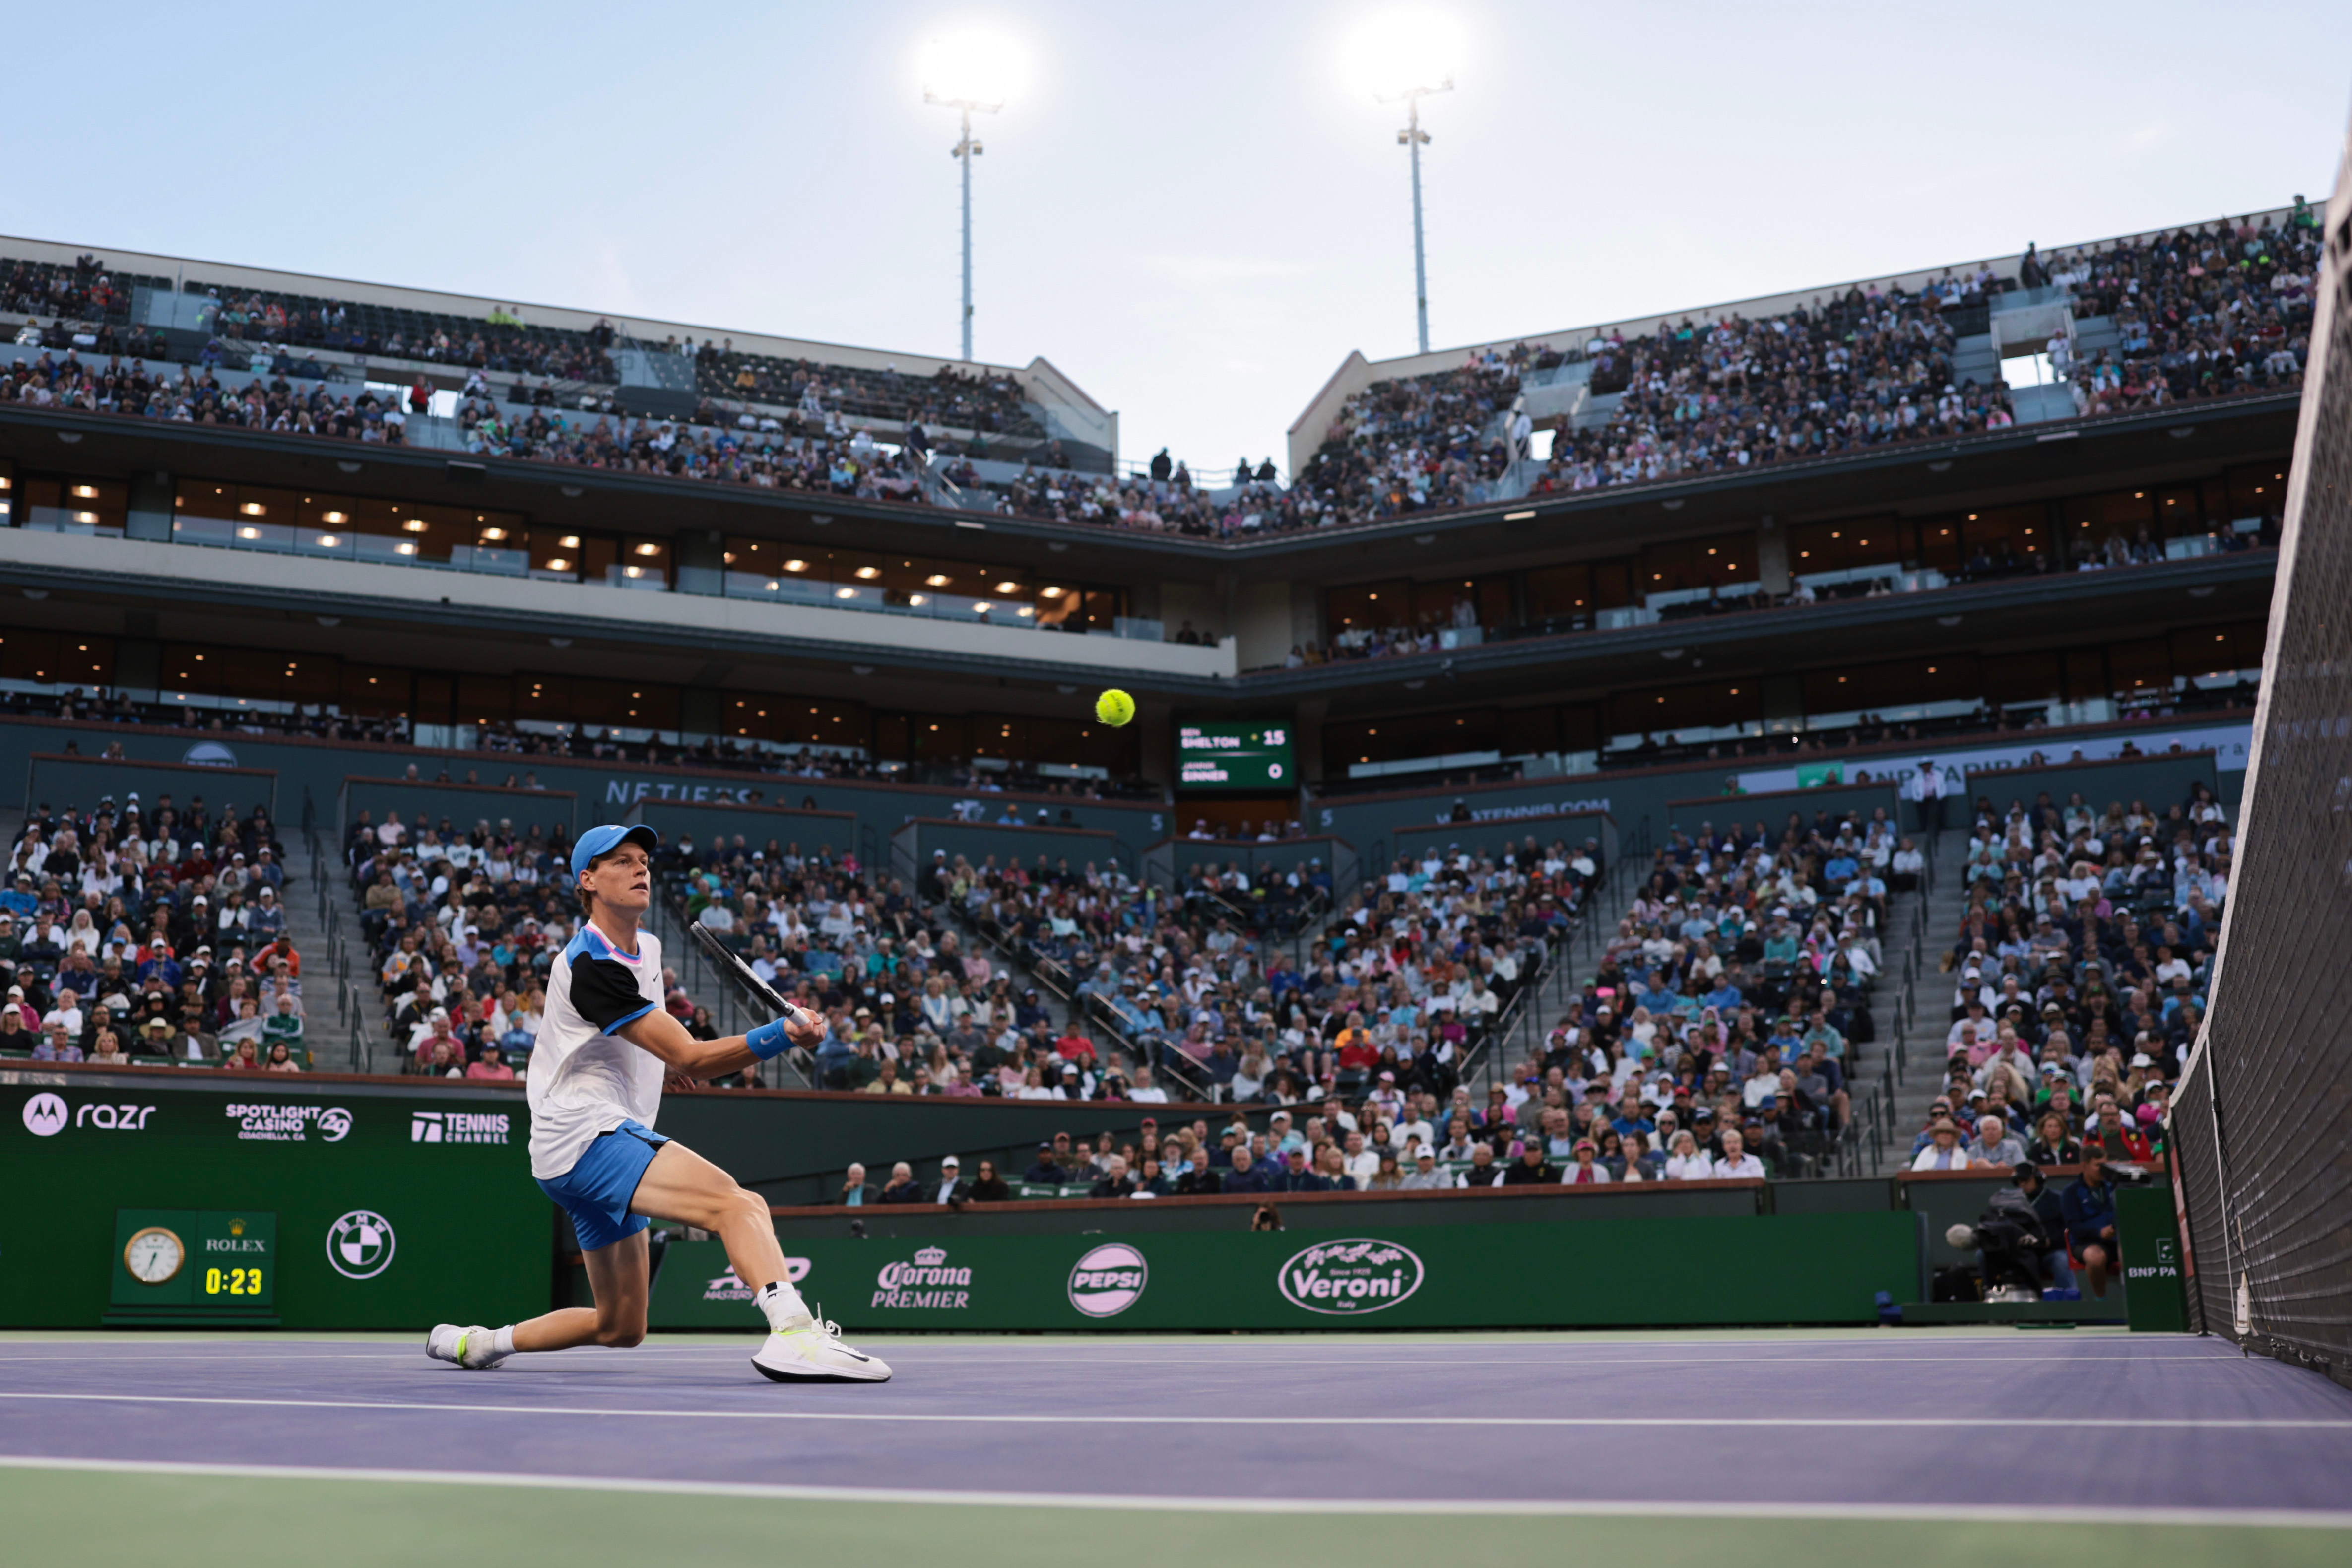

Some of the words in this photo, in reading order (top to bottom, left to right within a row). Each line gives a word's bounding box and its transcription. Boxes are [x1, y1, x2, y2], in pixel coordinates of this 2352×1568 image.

[1181, 737, 1240, 748] SHELTON
[1263, 730, 1285, 745] 15
[1182, 770, 1228, 782] SINNER
[1268, 763, 1283, 779] 0
[77, 1104, 156, 1130] razr
[226, 1104, 322, 1119] SPOTLIGHT
[241, 1117, 304, 1132] CASINO
[445, 1113, 509, 1133] TENNIS
[445, 1133, 509, 1144] CHANNEL
[336, 1214, 387, 1234] BMW
[206, 1239, 266, 1252] ROLEX
[206, 1268, 262, 1295] 0:23
[878, 1261, 972, 1291] Corona
[1074, 1272, 1142, 1289] PEPSI
[2128, 1267, 2157, 1278] BNP
[1292, 1269, 1403, 1298] Veroni
[871, 1291, 969, 1308] PREMIER
